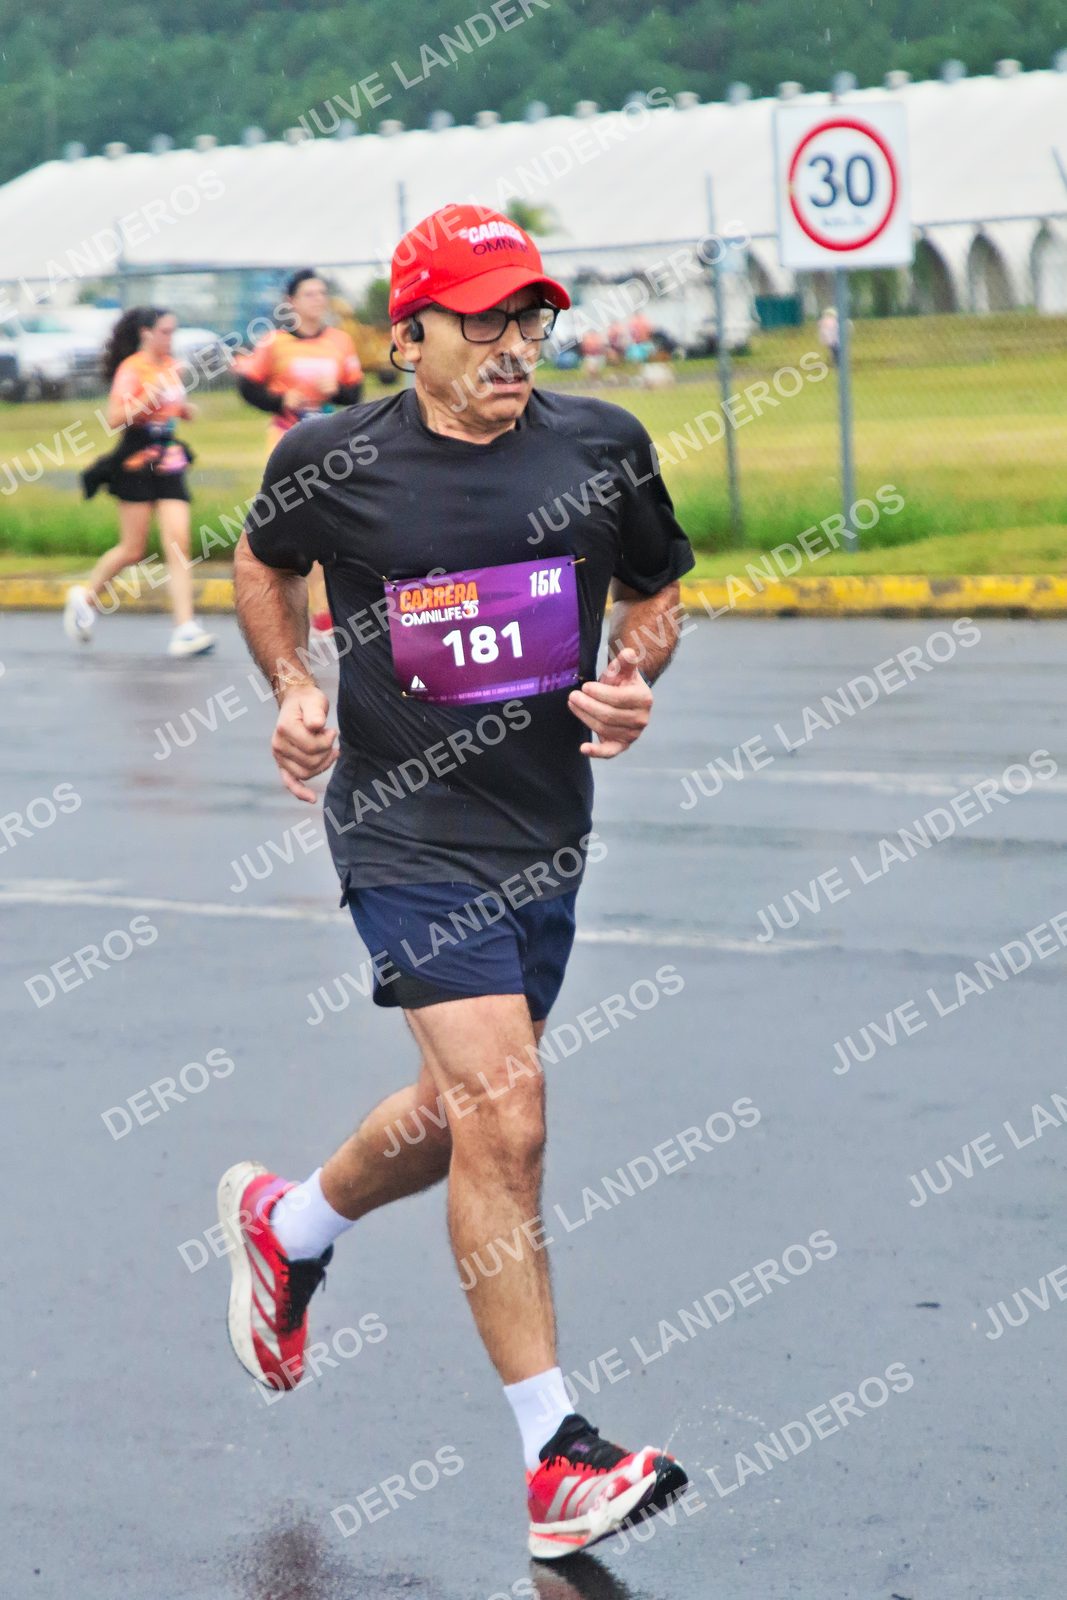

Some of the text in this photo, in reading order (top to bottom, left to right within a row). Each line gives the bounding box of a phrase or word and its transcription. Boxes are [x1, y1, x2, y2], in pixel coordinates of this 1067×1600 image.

[808, 153, 875, 208] 30
[399, 581, 479, 612] CARRERA
[529, 567, 562, 597] 15K
[401, 606, 463, 627] OMNILIFE
[442, 621, 523, 667] 181
